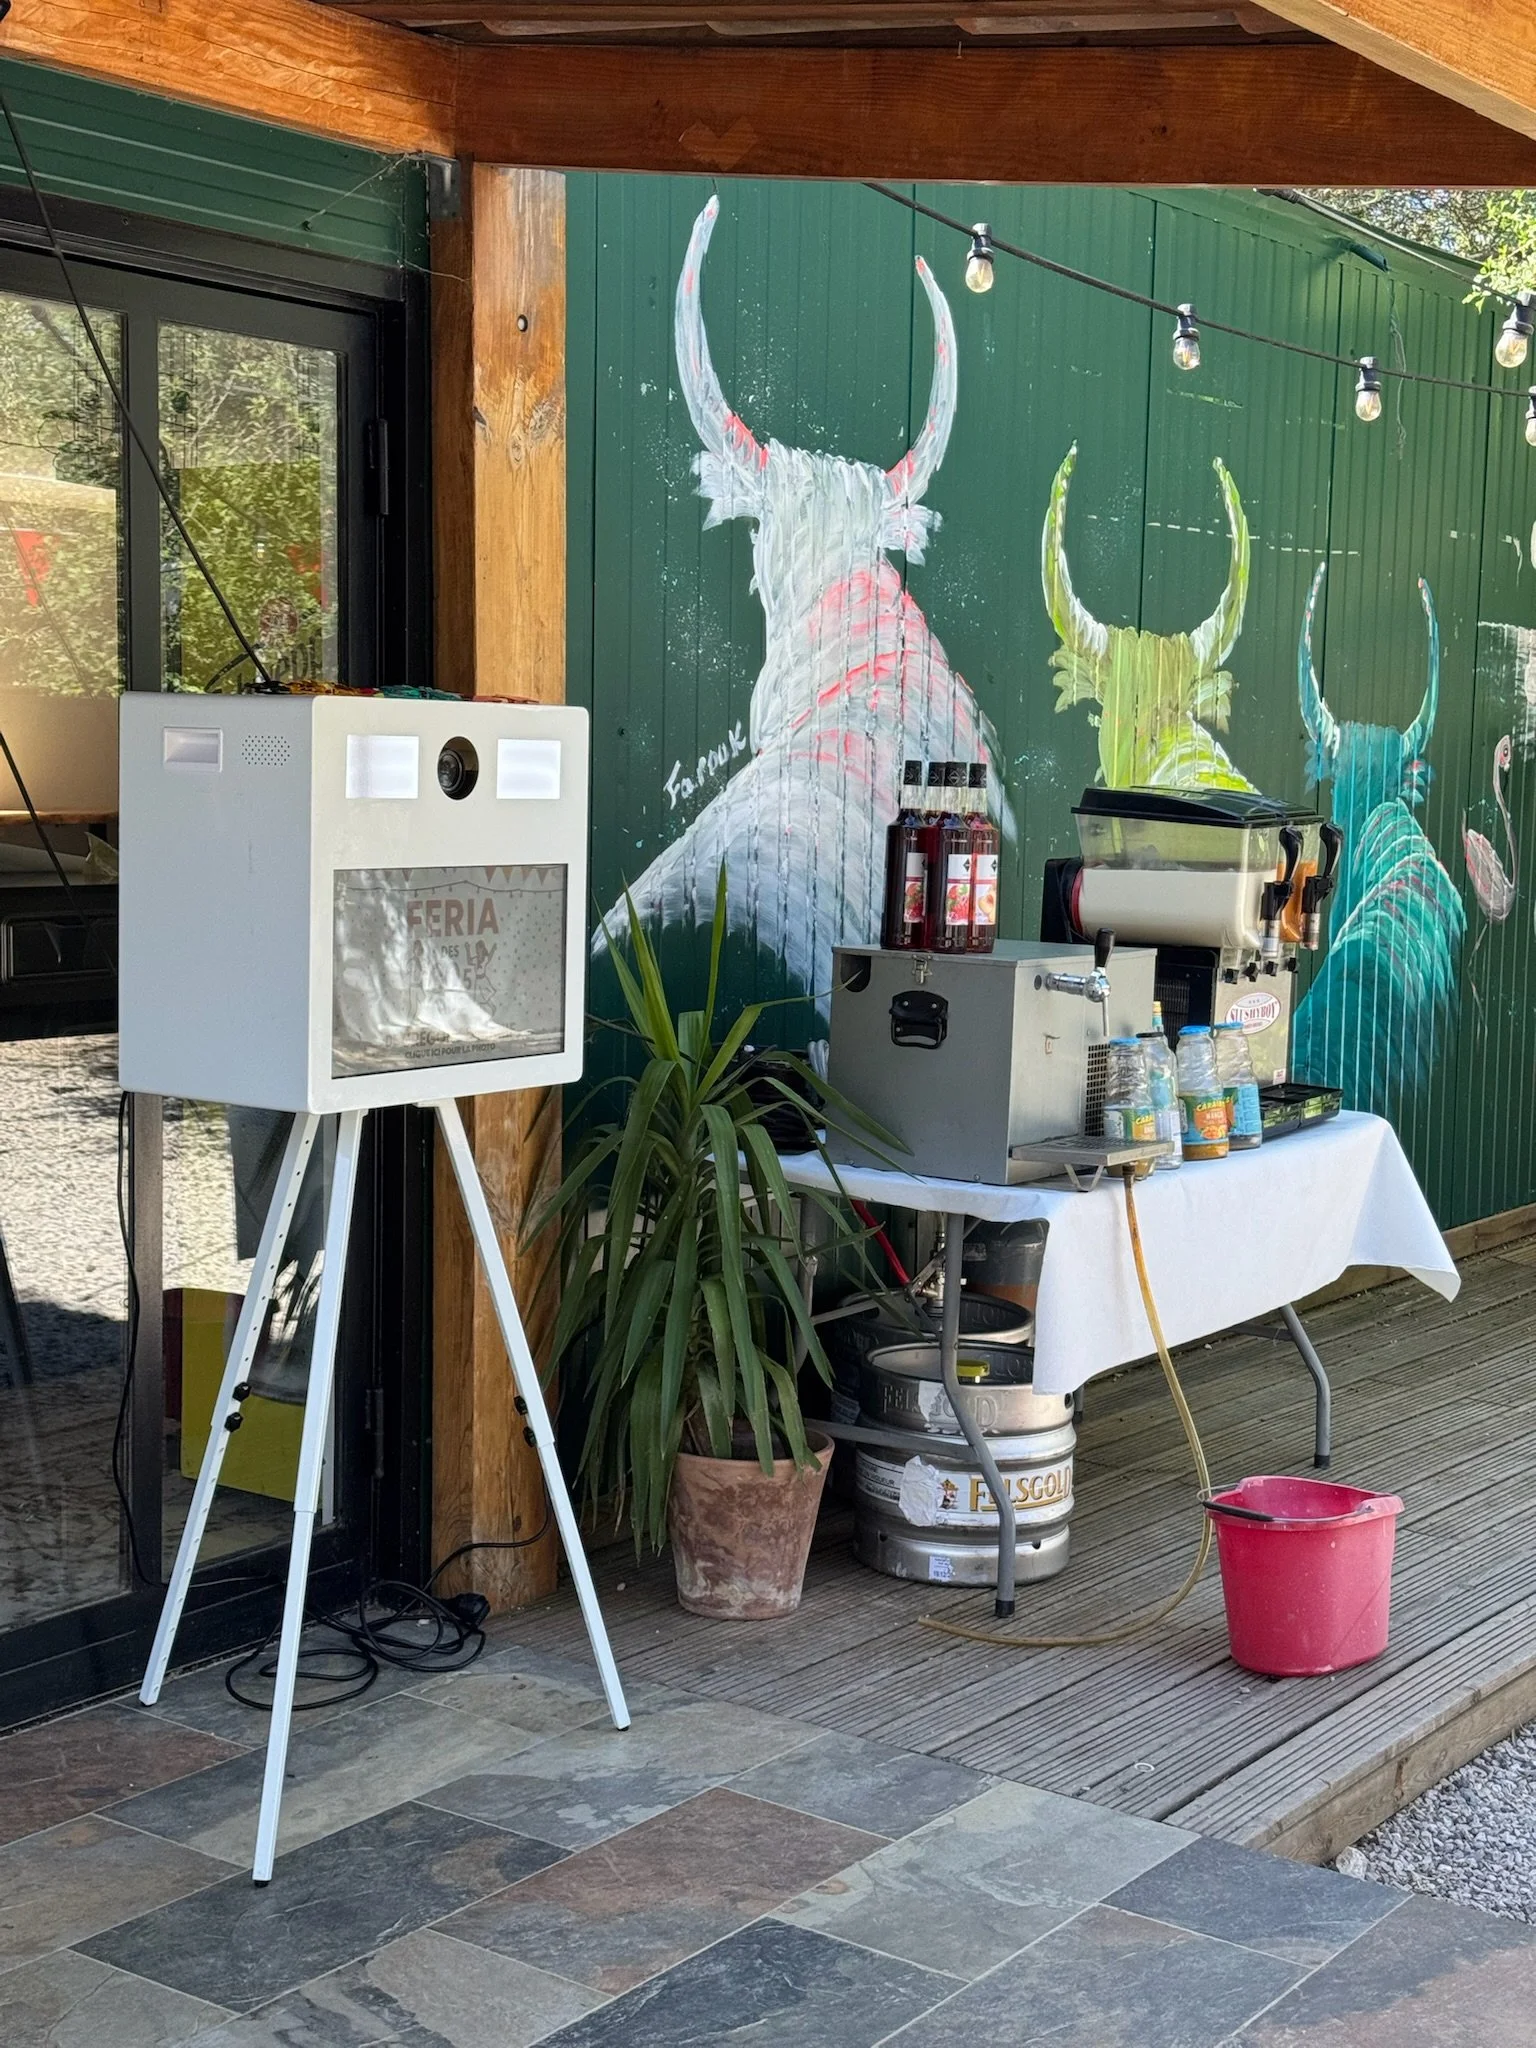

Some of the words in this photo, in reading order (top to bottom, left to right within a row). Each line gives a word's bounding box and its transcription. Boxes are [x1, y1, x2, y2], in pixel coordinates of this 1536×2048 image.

[407, 897, 500, 938] FERIA
[441, 944, 460, 959] DES
[442, 1045, 461, 1057] POUR
[472, 1042, 496, 1054] PHOTO
[969, 1465, 1072, 1512] FLSGOLD
